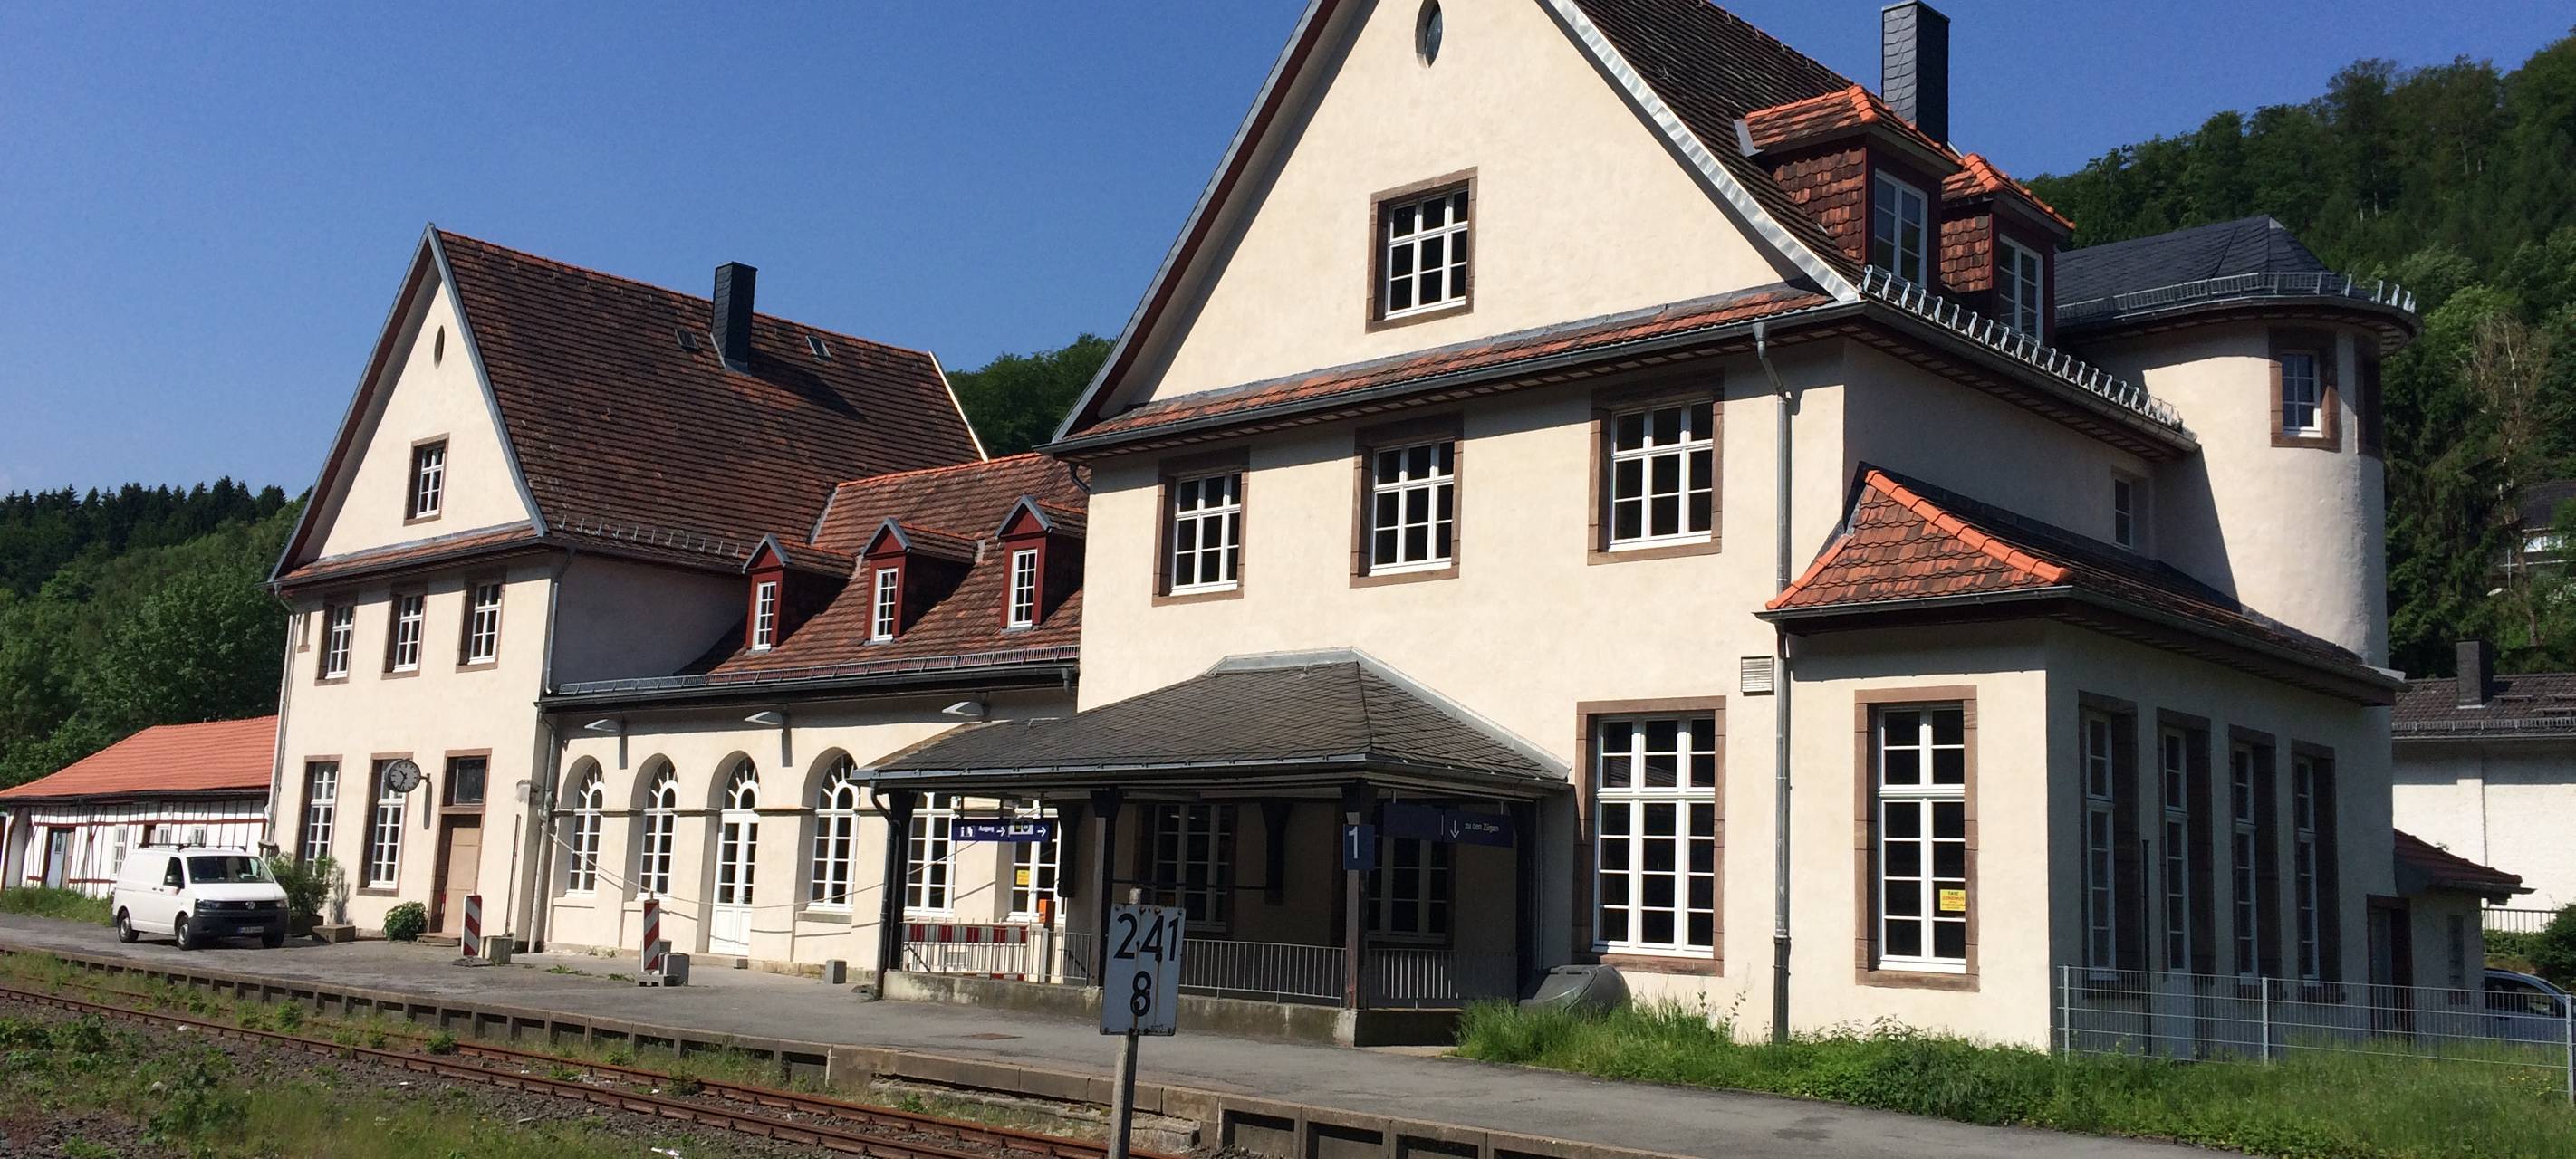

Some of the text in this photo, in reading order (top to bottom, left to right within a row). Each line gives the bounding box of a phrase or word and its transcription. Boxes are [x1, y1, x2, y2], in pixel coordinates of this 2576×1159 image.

[1349, 826, 1359, 859] 1
[1113, 913, 1179, 962] 241
[1130, 971, 1151, 1016] 8
